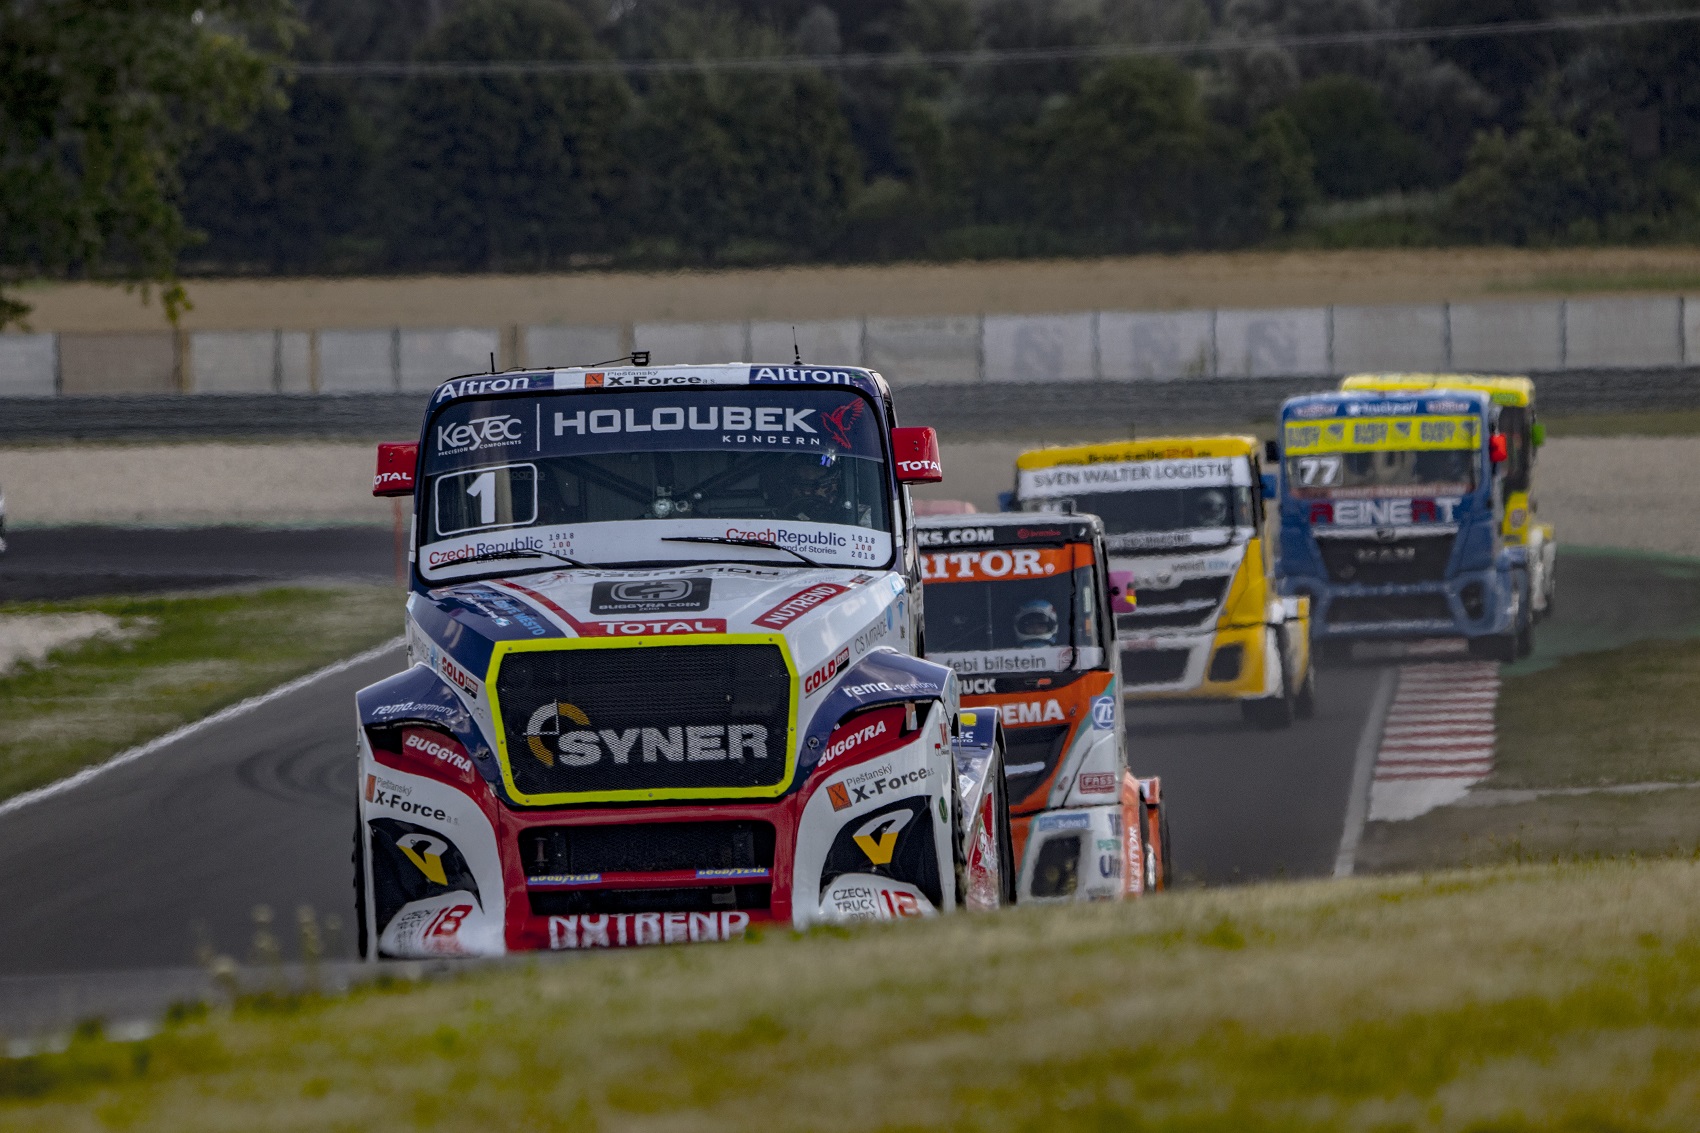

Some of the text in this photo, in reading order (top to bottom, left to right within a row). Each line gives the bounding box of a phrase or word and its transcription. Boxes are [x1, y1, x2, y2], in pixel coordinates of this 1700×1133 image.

[608, 376, 701, 387] X-Force
[755, 367, 850, 385] Altron
[436, 377, 529, 403] Altron
[554, 406, 818, 436] HOLOUBEK
[438, 415, 522, 450] KeyTec
[722, 435, 820, 445] KONCERN
[438, 440, 522, 456] PRECISION COMPONENTS
[373, 472, 412, 486] OTAL
[1034, 463, 1233, 488] SVEN WALTER LOGISTIK
[1301, 459, 1340, 485] 77
[466, 471, 496, 524] 1
[549, 532, 575, 541] 1918
[552, 541, 572, 549] 100
[851, 534, 876, 544] 1918
[917, 528, 995, 546] KS.COM
[808, 545, 837, 555] Stories
[851, 551, 876, 561] 2018
[855, 543, 872, 552] 100
[764, 585, 837, 625] NUTREND
[598, 621, 717, 635] TOTAL
[947, 654, 1047, 672] febi bilstein
[805, 659, 836, 693] GOLD
[960, 678, 997, 694] UCK
[1000, 698, 1065, 725] EMA
[406, 734, 473, 772] BUGGYRA
[558, 724, 768, 767] SYNER
[817, 720, 887, 768] BUGGYRA
[852, 765, 927, 804] X-Force
[375, 788, 446, 821] X-Force
[832, 887, 872, 900] CZECH
[834, 899, 876, 912] TRUCK
